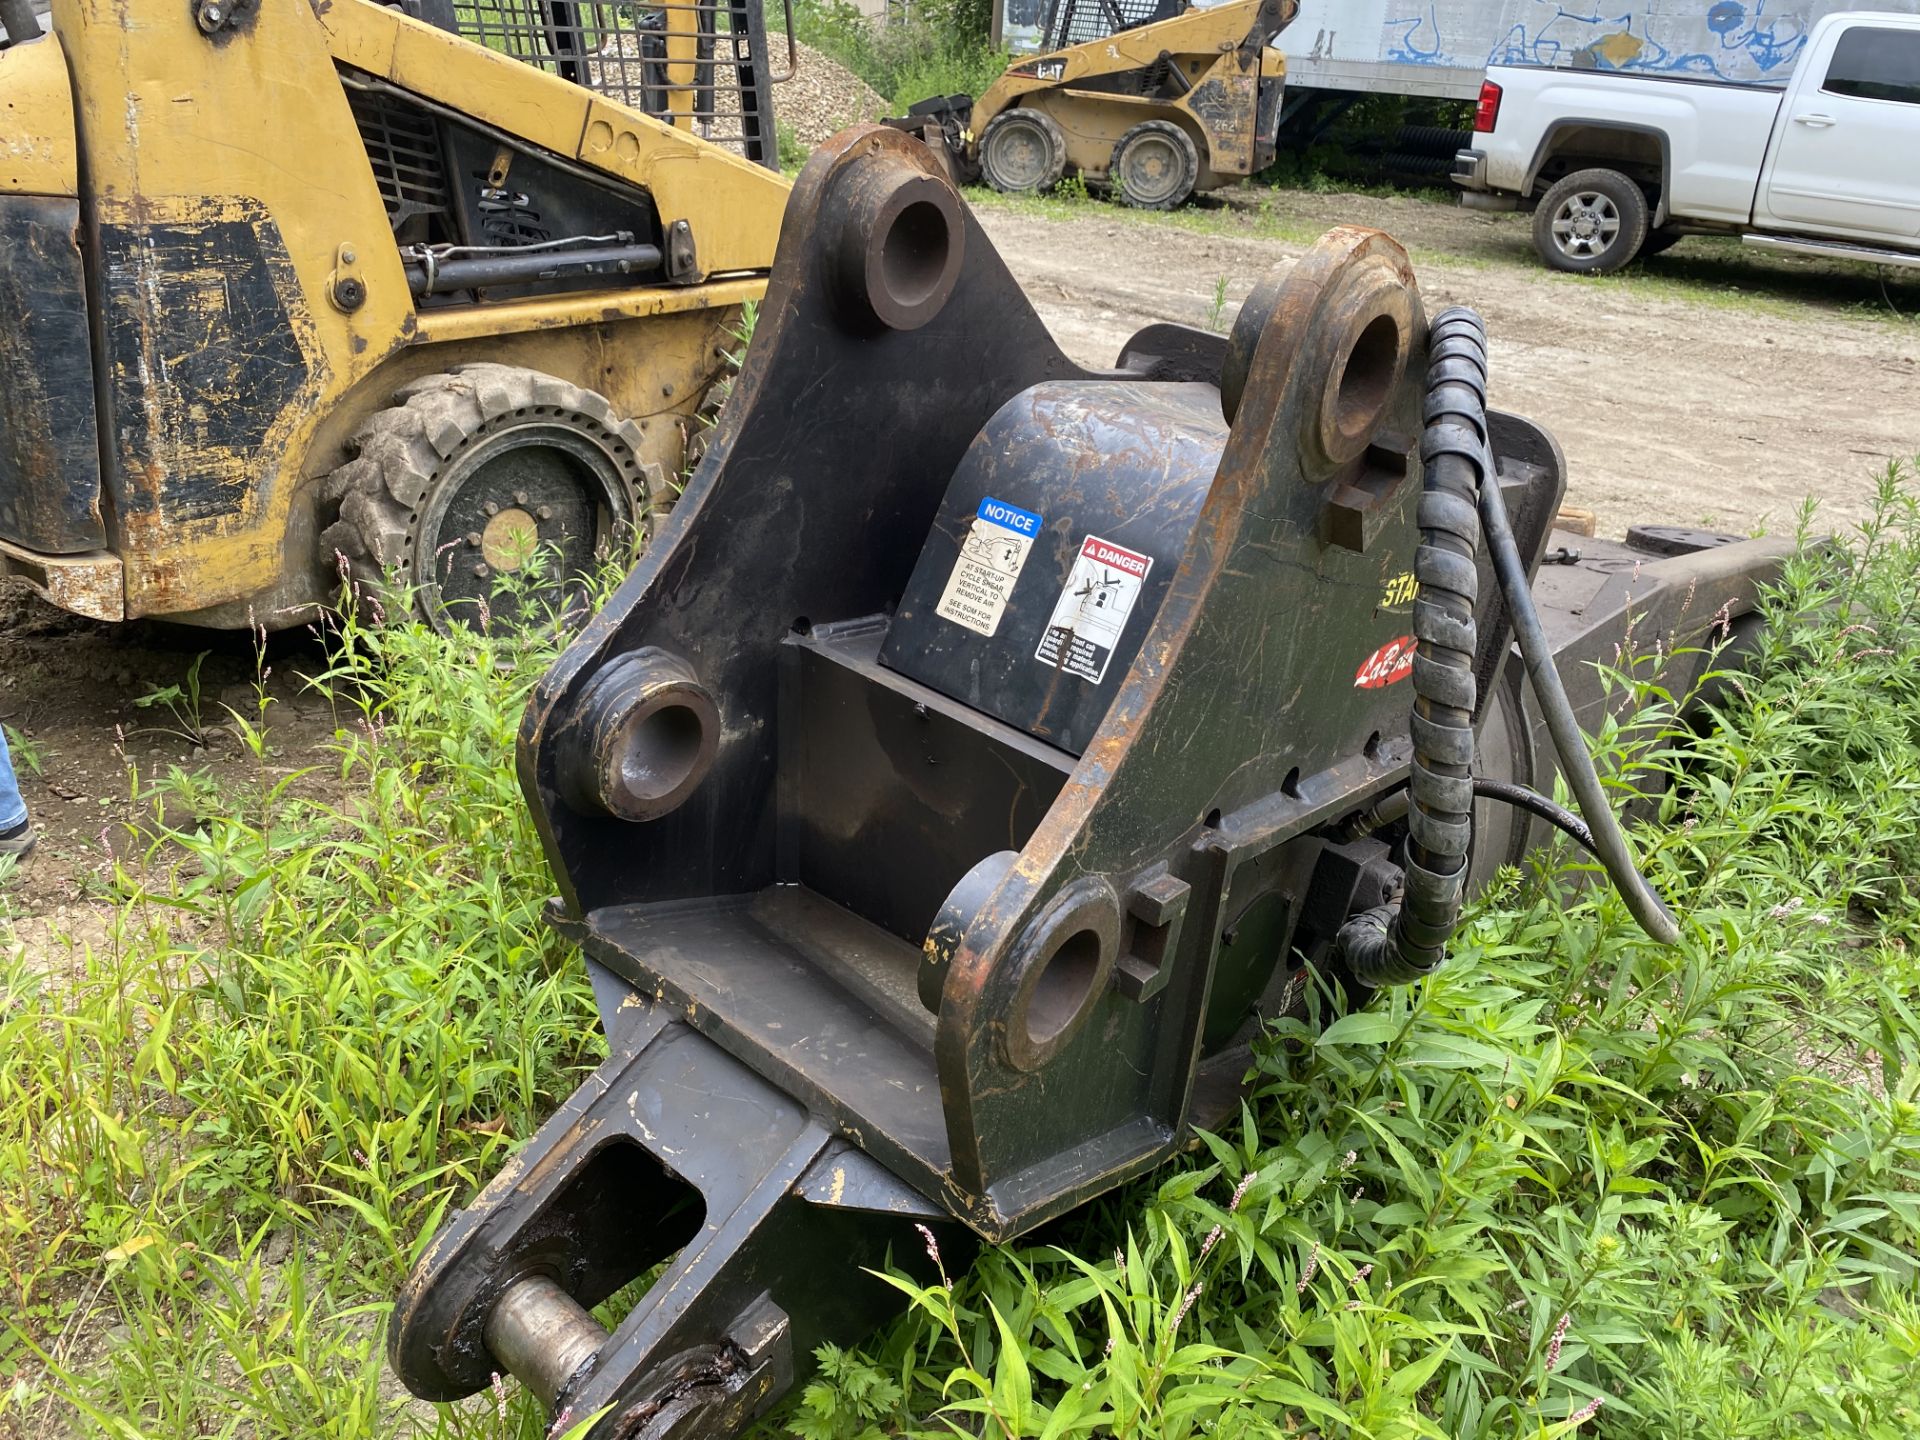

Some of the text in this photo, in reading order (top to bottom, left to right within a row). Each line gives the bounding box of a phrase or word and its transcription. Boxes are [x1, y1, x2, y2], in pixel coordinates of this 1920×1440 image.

[984, 503, 1034, 532] NOTICE
[1097, 547, 1145, 575] DANGER
[960, 571, 1004, 592] CYCLE SHEAR
[965, 563, 1004, 583] AT START-UP
[956, 588, 995, 608] REMOVE AIR
[959, 579, 999, 600] VERTICAL TO
[944, 606, 990, 631] INSTRUCTIONS
[948, 598, 961, 609] SEE
[978, 610, 992, 622] FOR
